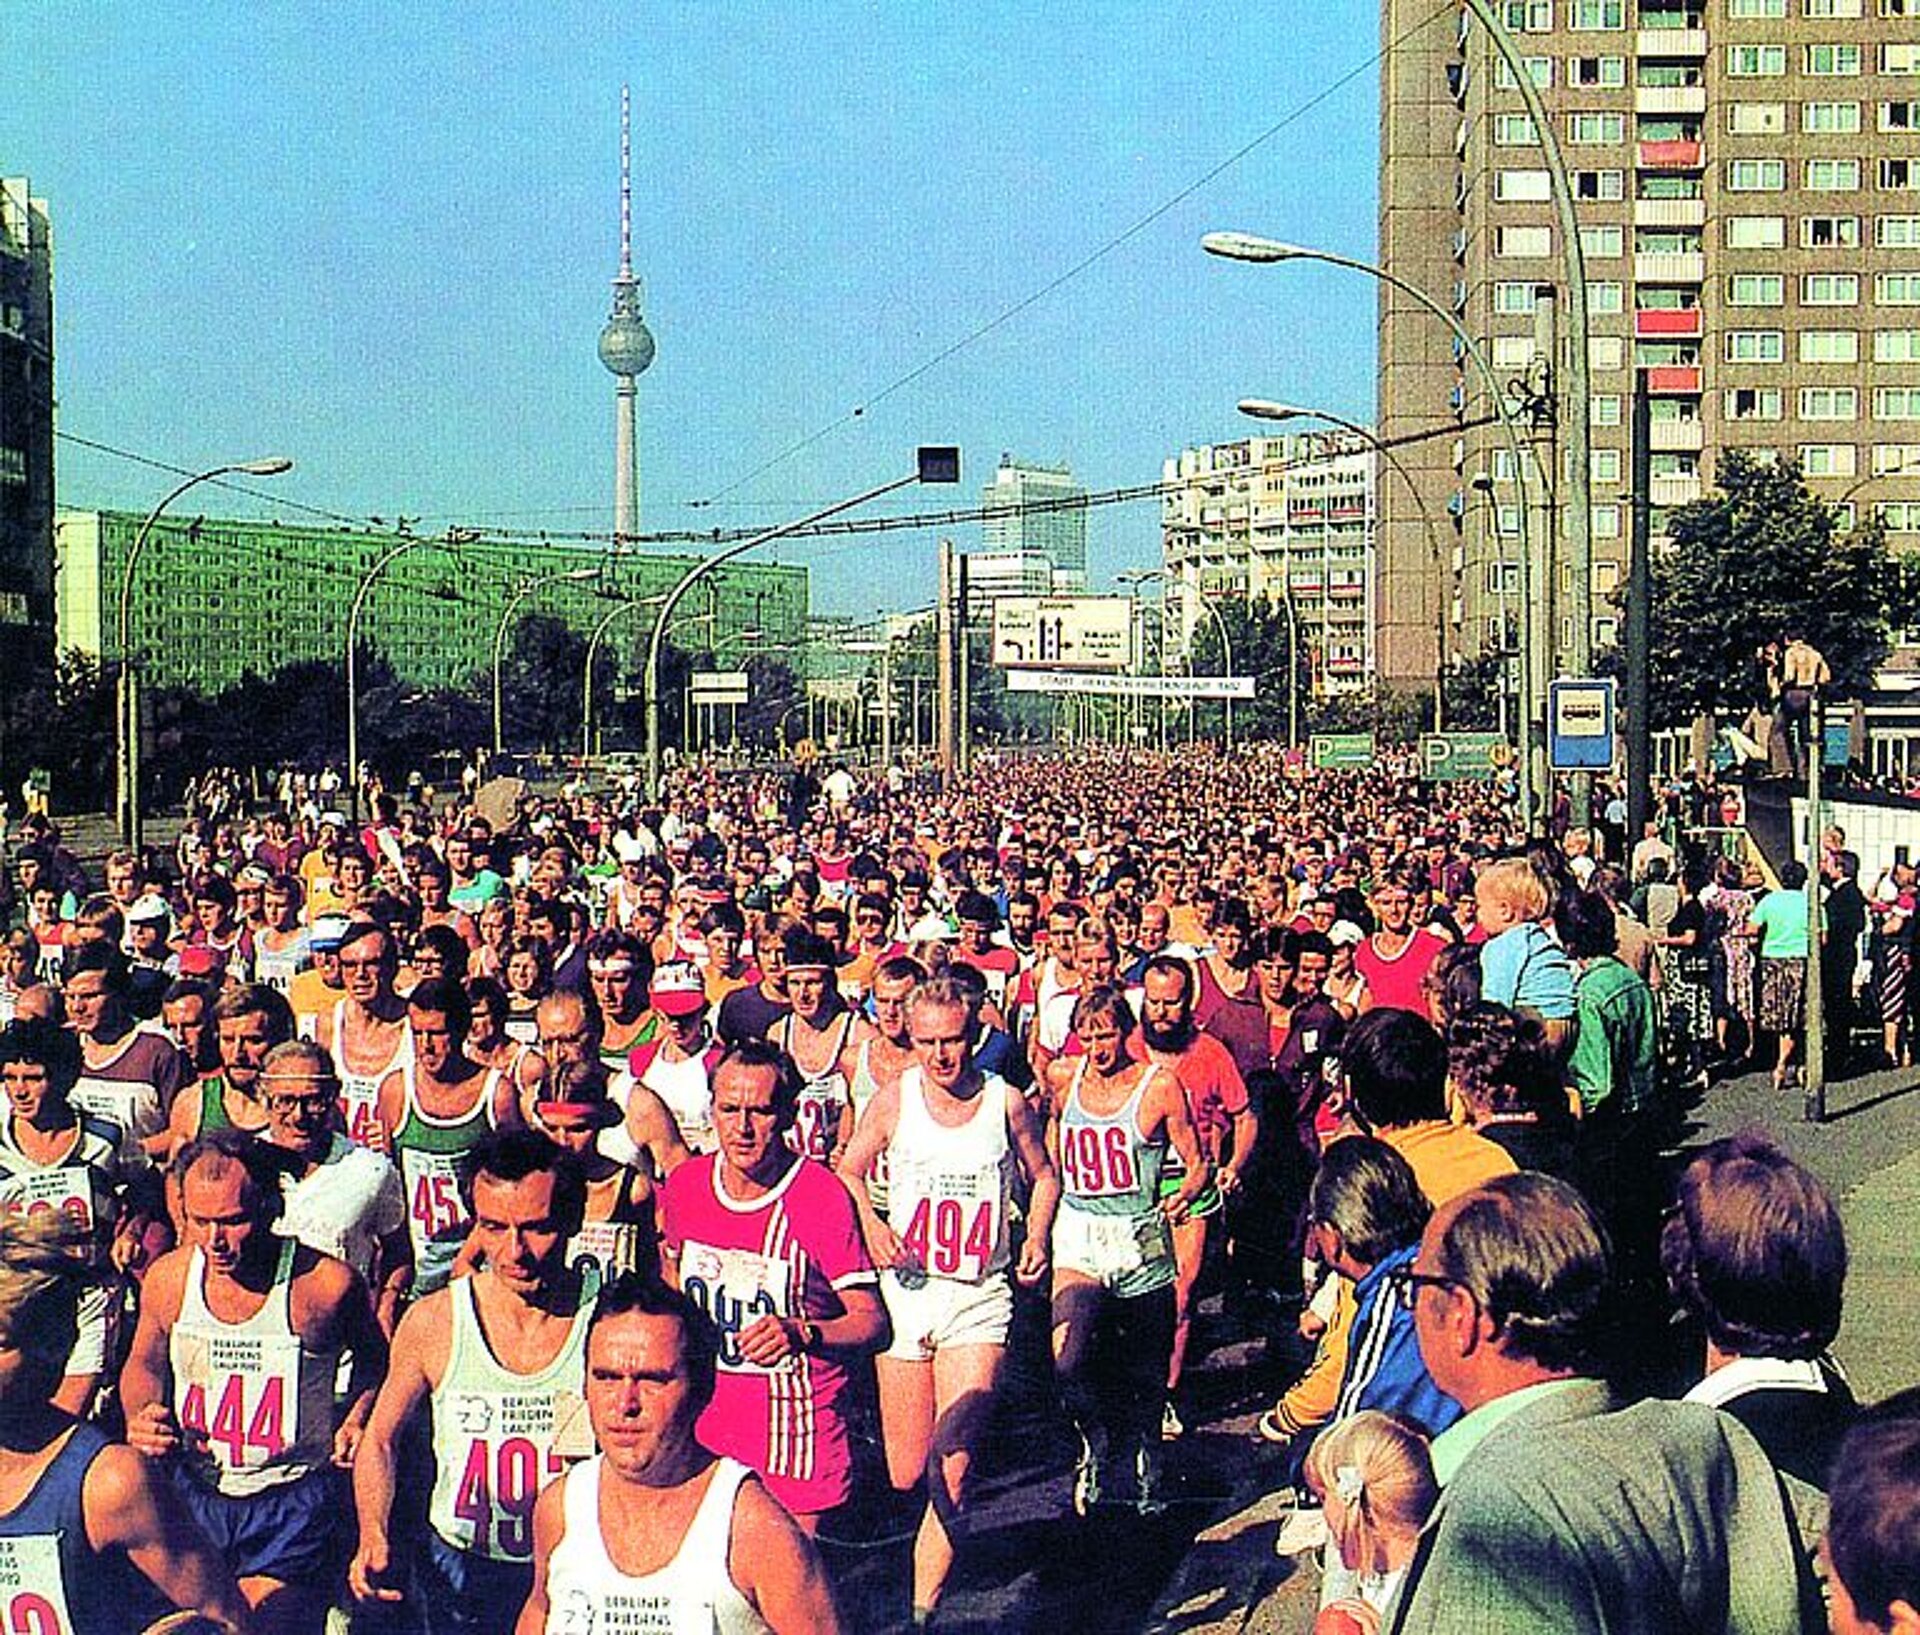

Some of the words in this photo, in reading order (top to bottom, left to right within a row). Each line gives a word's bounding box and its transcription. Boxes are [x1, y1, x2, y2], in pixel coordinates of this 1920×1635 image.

[1314, 738, 1334, 766] P
[1426, 739, 1451, 776] P
[1064, 1126, 1134, 1192] 496
[902, 1197, 992, 1276] 494
[182, 1373, 286, 1468] 444
[502, 1395, 556, 1409] BERLINE
[454, 1437, 564, 1558] 49
